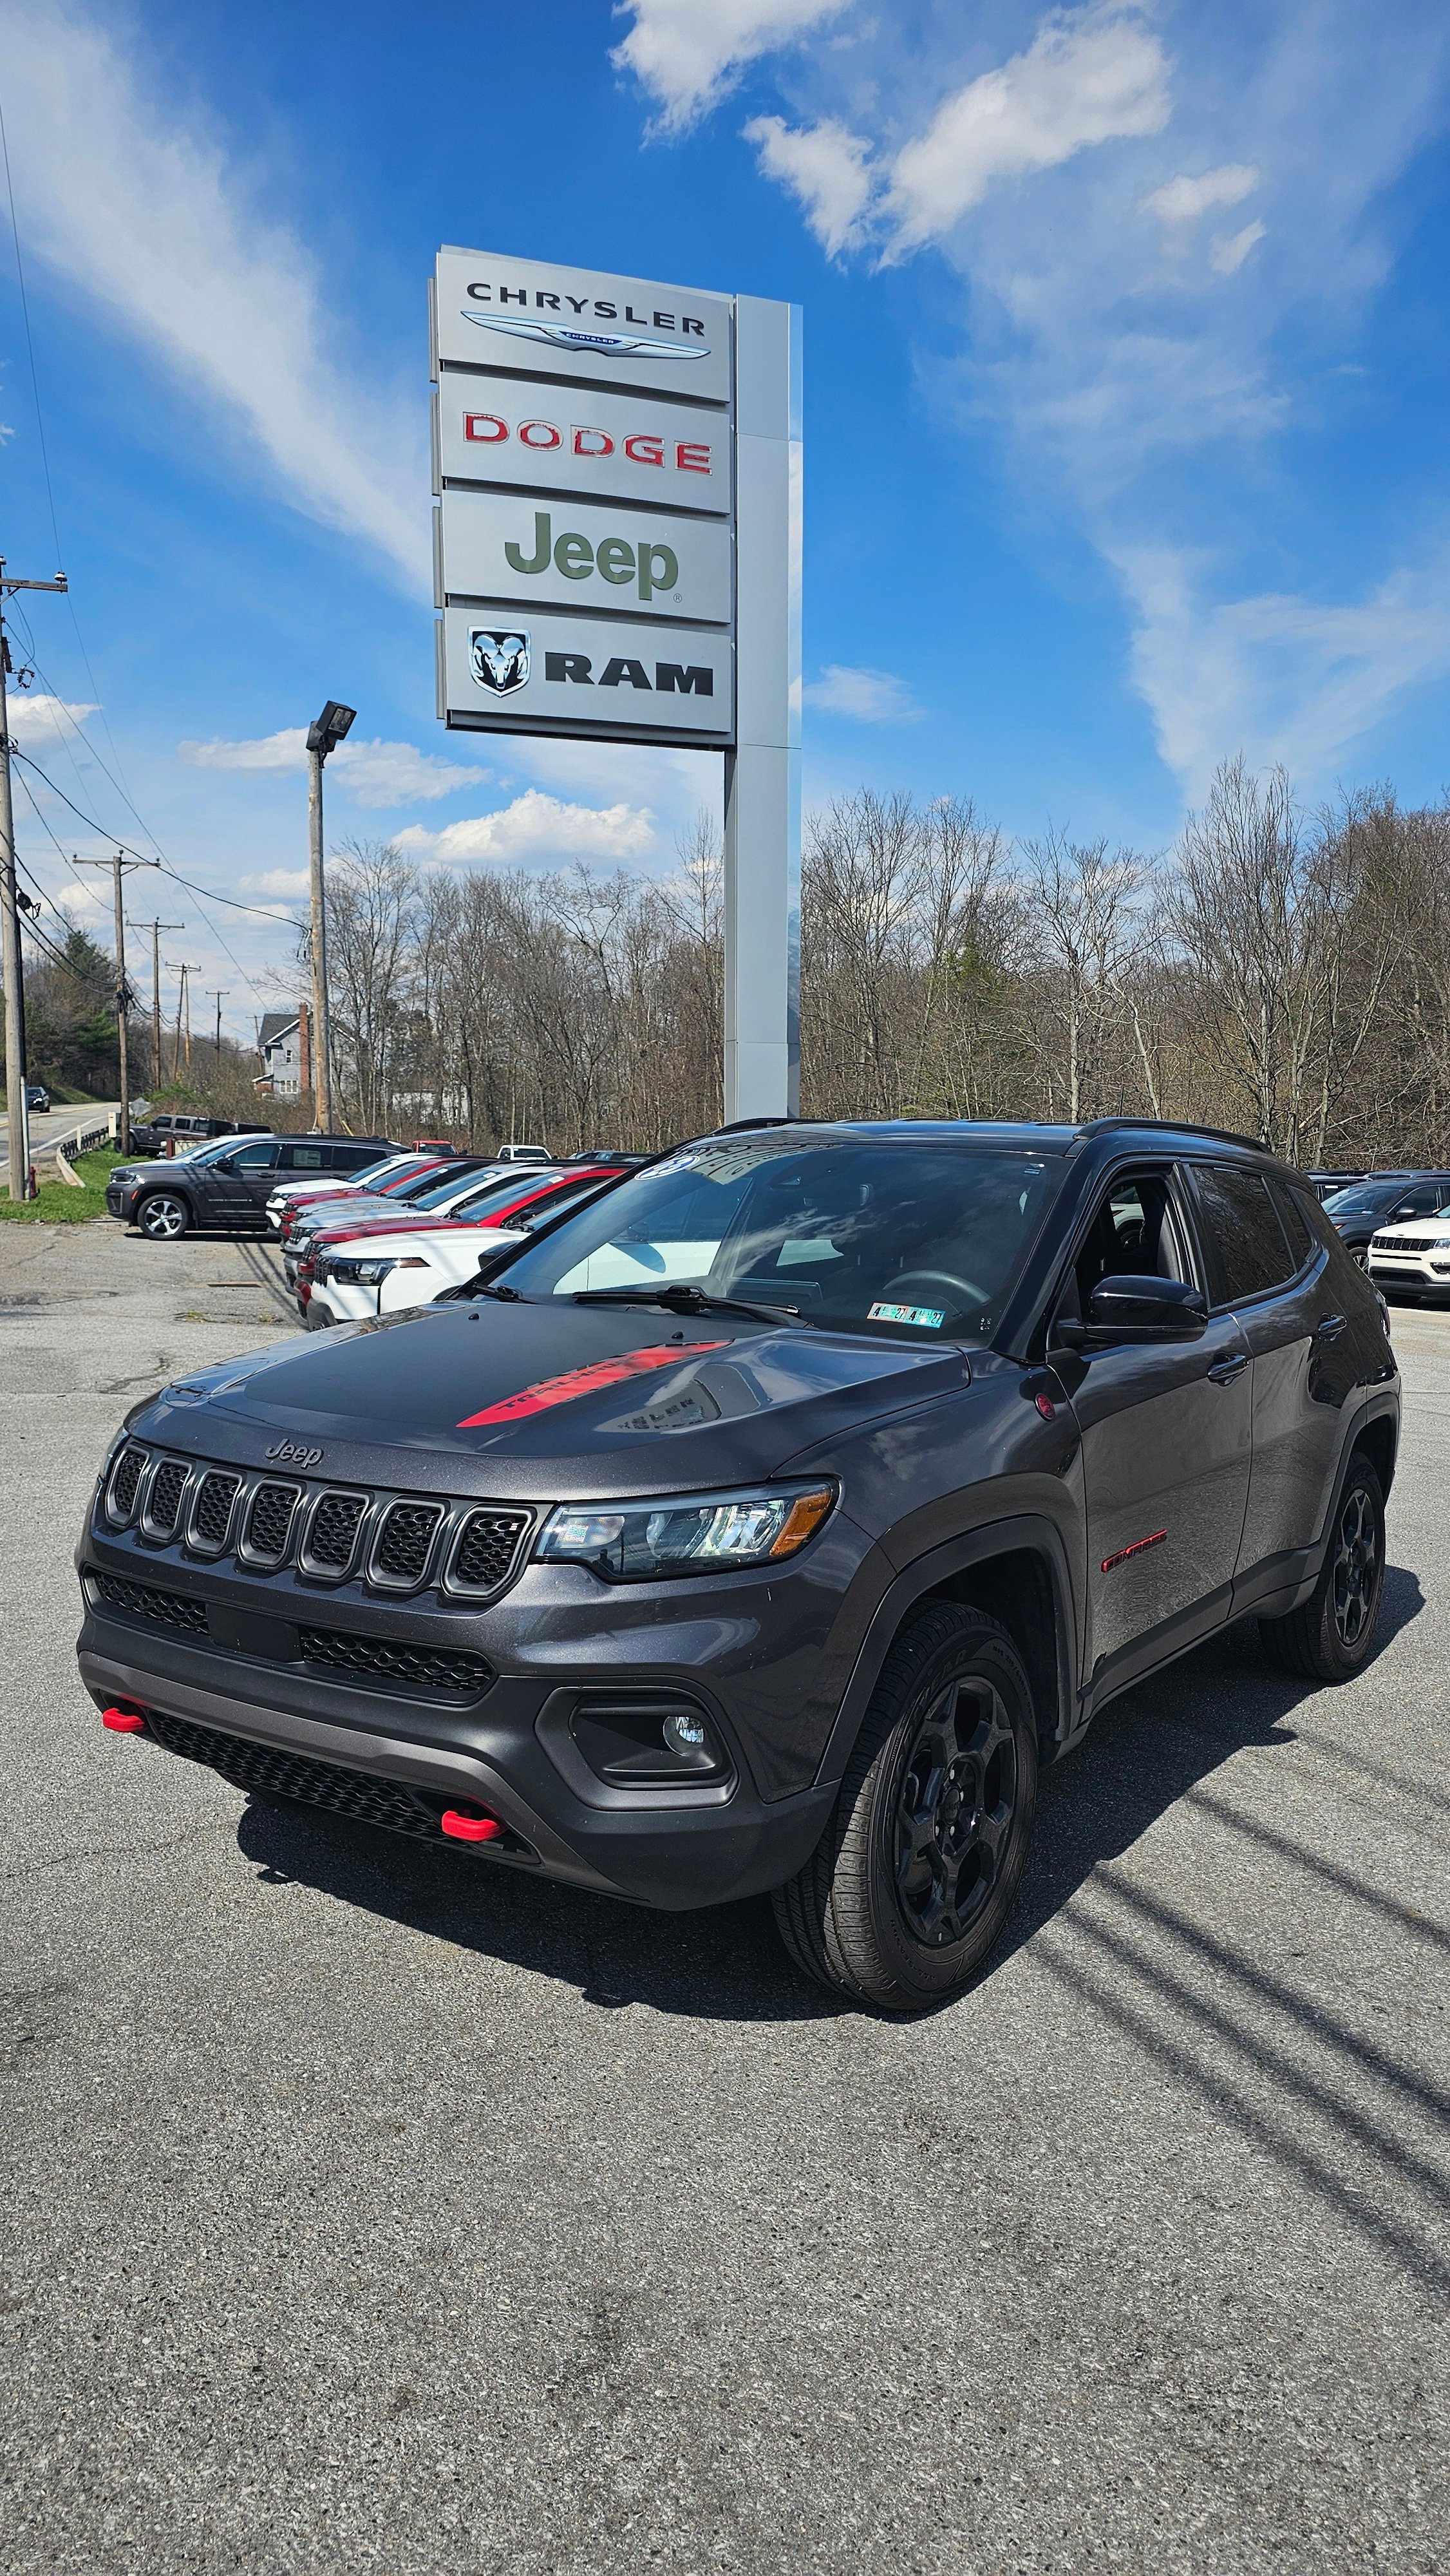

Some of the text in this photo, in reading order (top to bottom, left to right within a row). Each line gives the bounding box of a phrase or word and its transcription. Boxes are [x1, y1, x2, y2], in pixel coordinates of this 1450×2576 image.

[467, 283, 704, 337] CHRYSLER
[566, 333, 614, 344] CHRYSLER
[463, 412, 713, 475] DODGE
[505, 512, 678, 601] Jeep
[545, 652, 713, 696] RAM
[873, 1307, 907, 1320] 4 27
[910, 1311, 942, 1325] 4 27
[265, 1438, 324, 1470] Jeep
